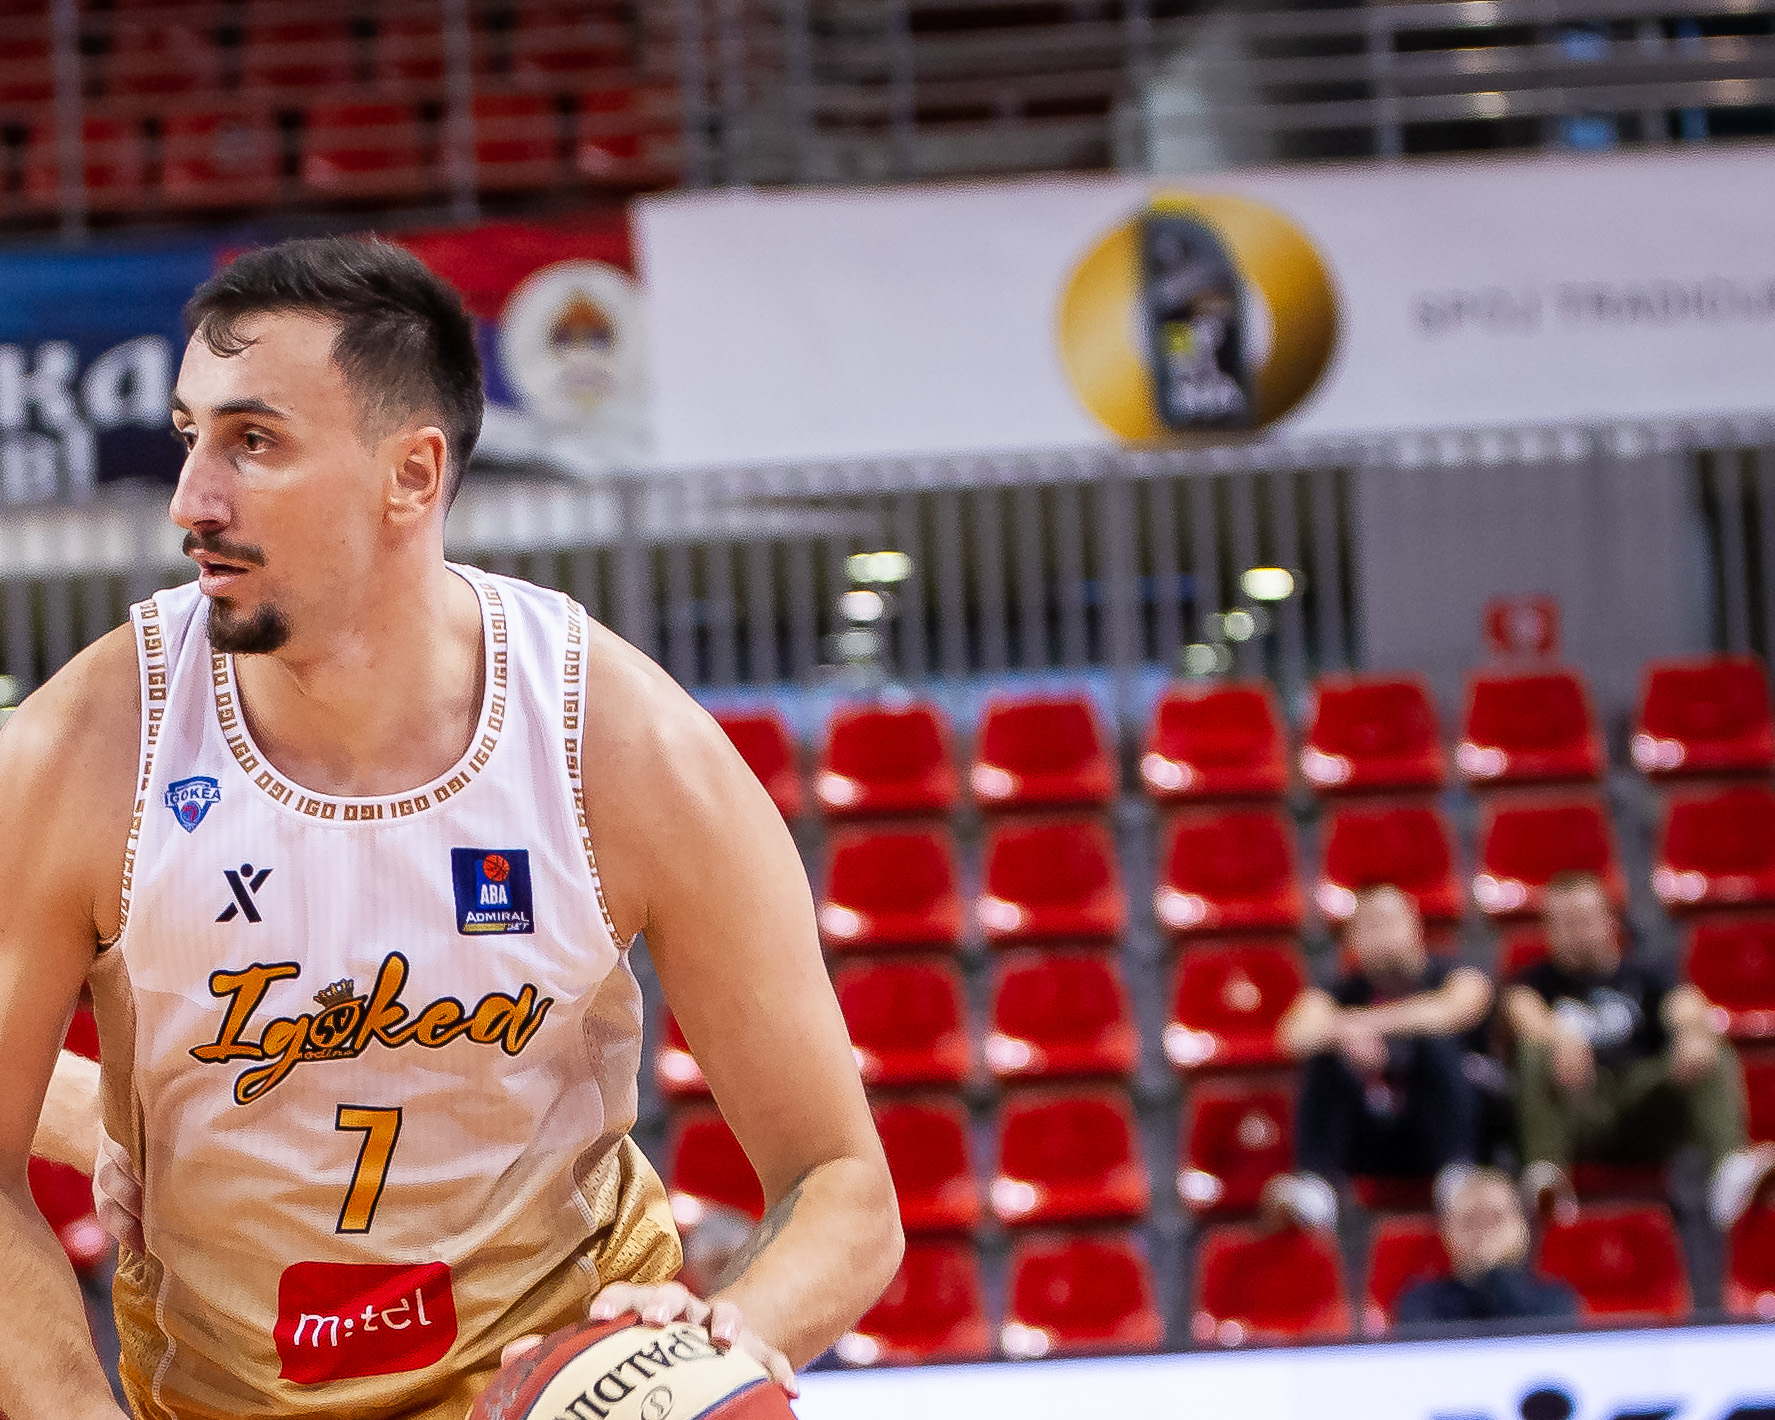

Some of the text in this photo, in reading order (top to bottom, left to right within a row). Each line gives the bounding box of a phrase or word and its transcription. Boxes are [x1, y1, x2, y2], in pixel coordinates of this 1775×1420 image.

[465, 910, 530, 925] ADMIRAL
[480, 884, 508, 905] ABA
[190, 950, 555, 1106] Igokea
[335, 1103, 403, 1235] 7
